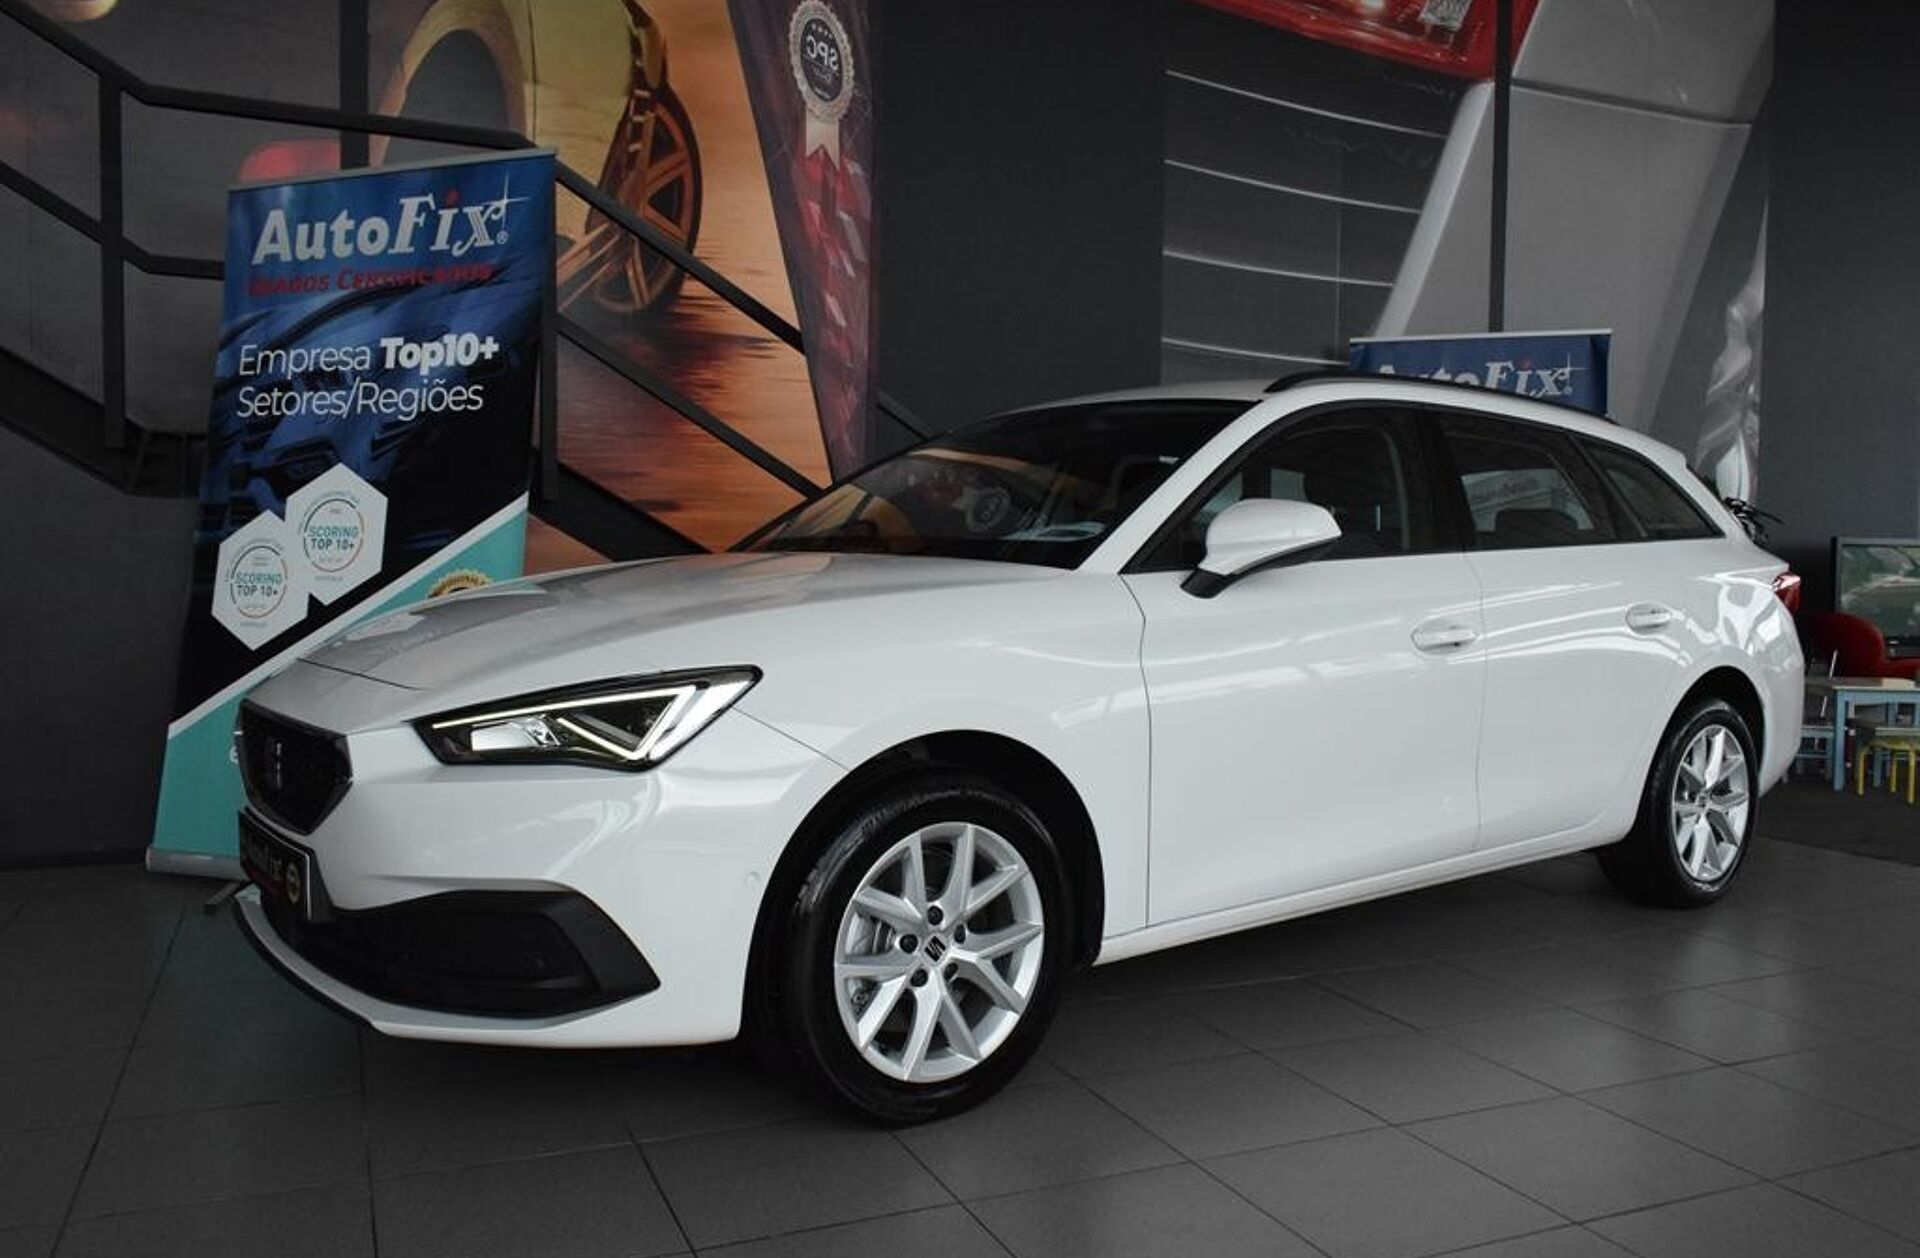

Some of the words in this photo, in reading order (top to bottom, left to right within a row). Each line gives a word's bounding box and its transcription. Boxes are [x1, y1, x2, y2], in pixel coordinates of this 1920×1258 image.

[251, 189, 506, 266] AutoFix
[239, 343, 372, 380] Empresa
[380, 332, 500, 376] Top10+
[236, 377, 485, 422] Setores/Regiões
[309, 526, 359, 539] SCORING
[310, 538, 333, 551] TOP
[235, 571, 283, 585] SCORING
[236, 584, 259, 598] TOP
